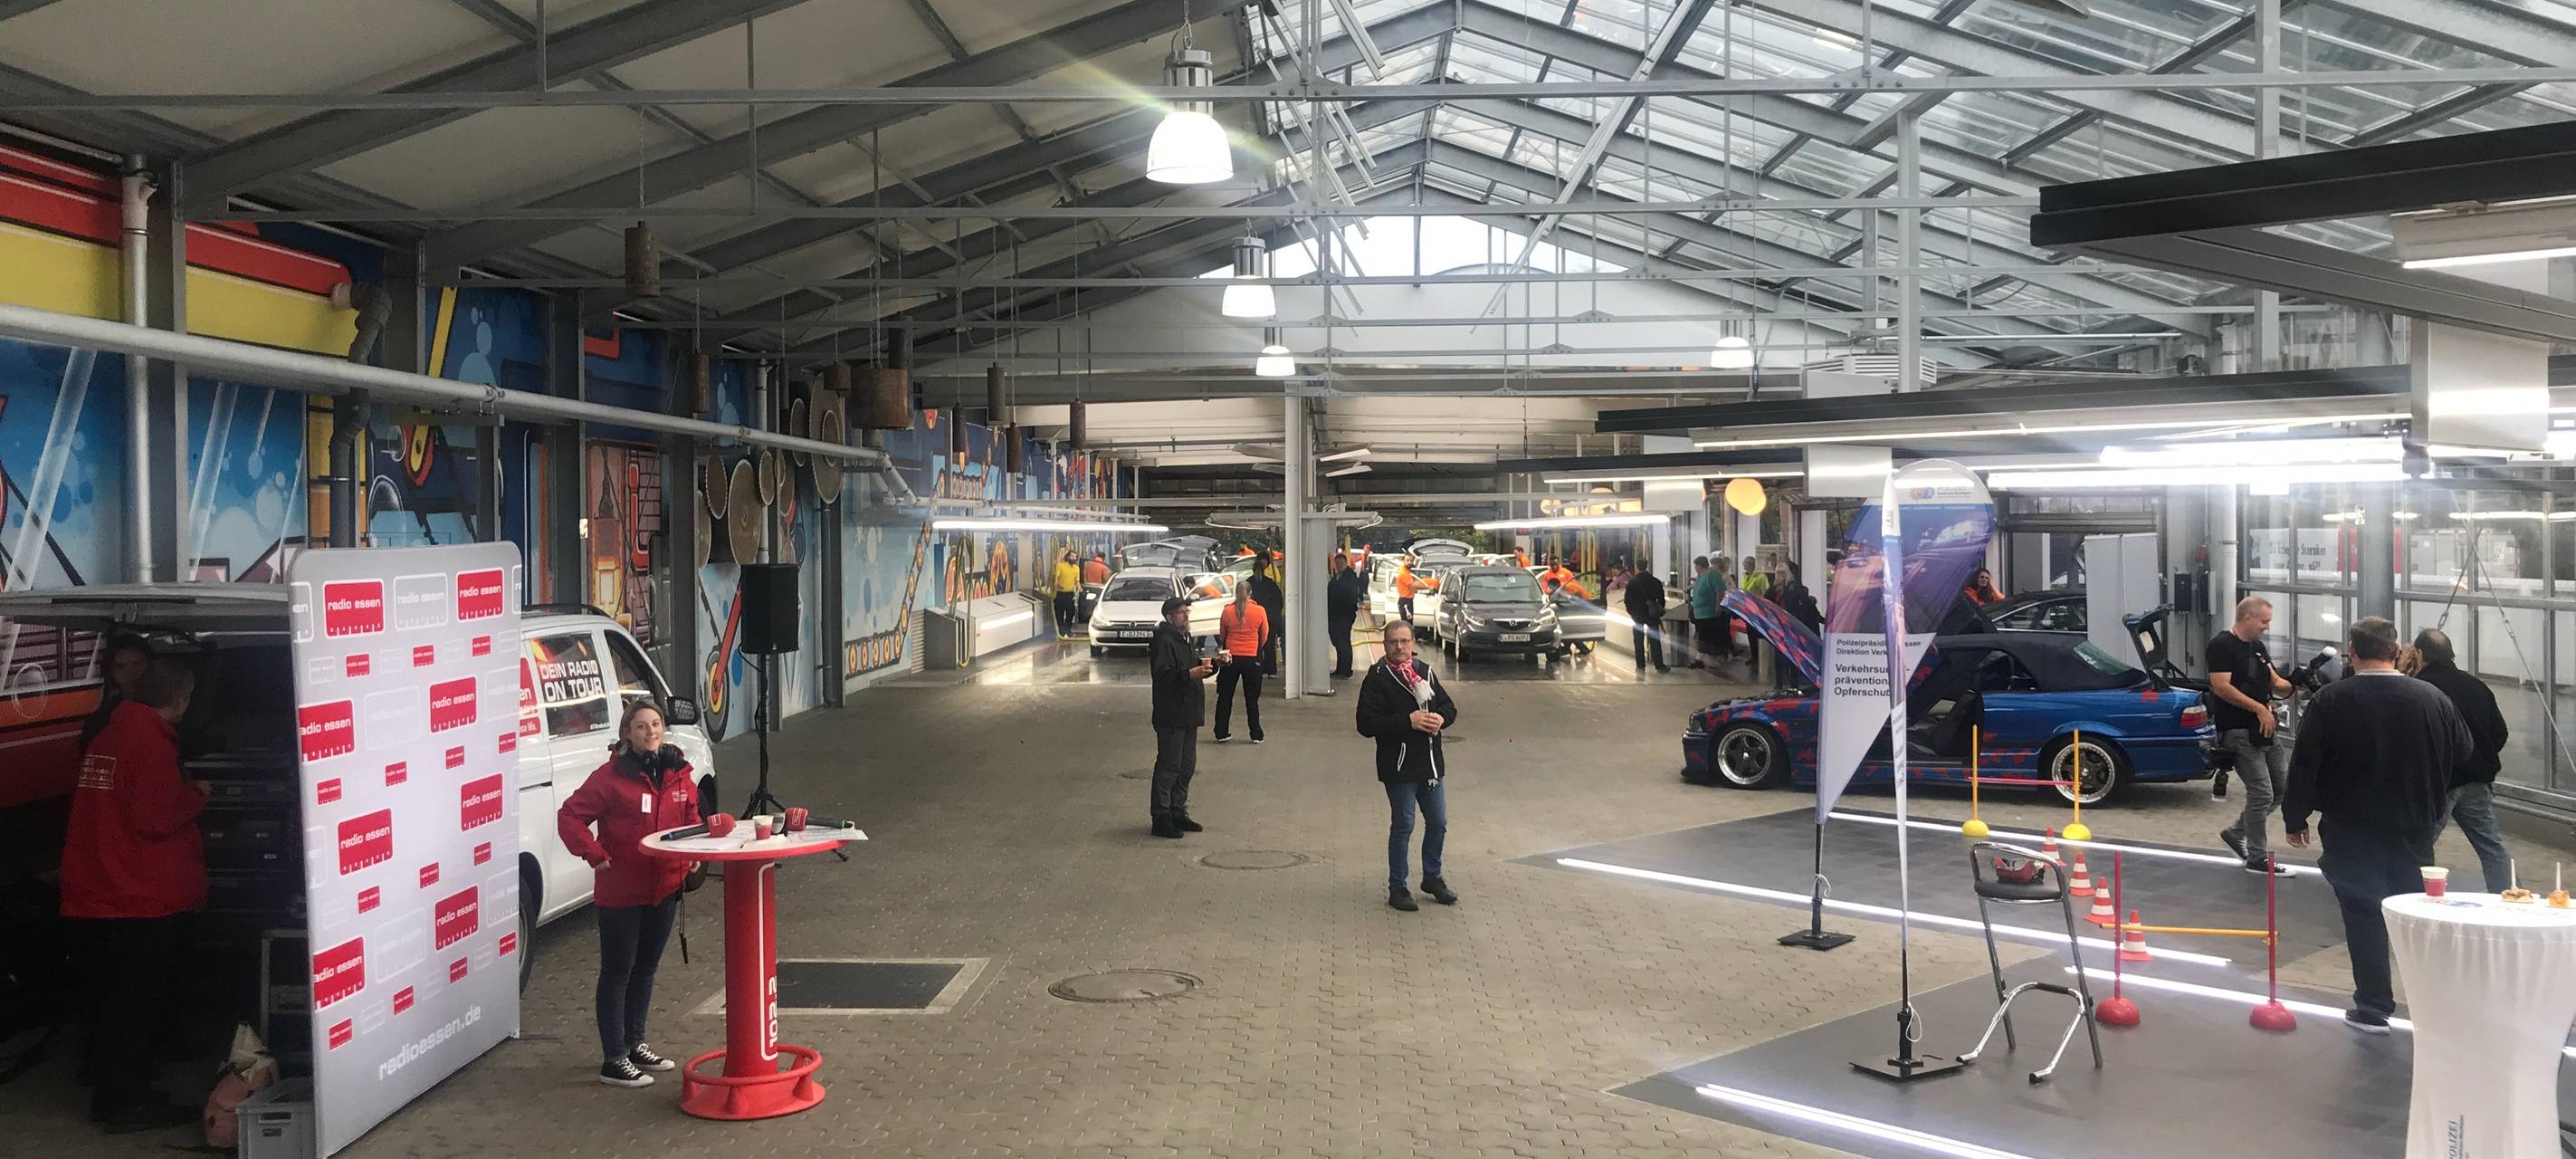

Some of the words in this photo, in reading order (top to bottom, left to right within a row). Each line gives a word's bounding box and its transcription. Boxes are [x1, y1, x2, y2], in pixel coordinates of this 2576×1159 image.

[459, 586, 479, 598] radio
[481, 585, 501, 595] essen
[328, 599, 352, 610] radio
[355, 599, 381, 609] essen
[1837, 639, 1886, 647] Polizeipräsidi
[1837, 647, 1869, 656] Direktion
[539, 662, 567, 680] DEIN
[568, 659, 598, 677] RADIO
[544, 680, 567, 703] ON
[568, 676, 604, 699] TOUR
[1834, 686, 1891, 697] Opferschut
[432, 695, 452, 710] radio
[453, 692, 475, 704] essen
[299, 722, 322, 736] adio
[324, 718, 351, 732] essen
[463, 795, 481, 809] radio
[482, 789, 501, 802] essen
[340, 833, 364, 850] radio
[365, 826, 390, 841] essen
[436, 908, 455, 926] radio
[456, 901, 477, 917] essen
[313, 967, 335, 983] adio
[337, 955, 363, 973] essen
[379, 1004, 482, 1080] radioessen.de
